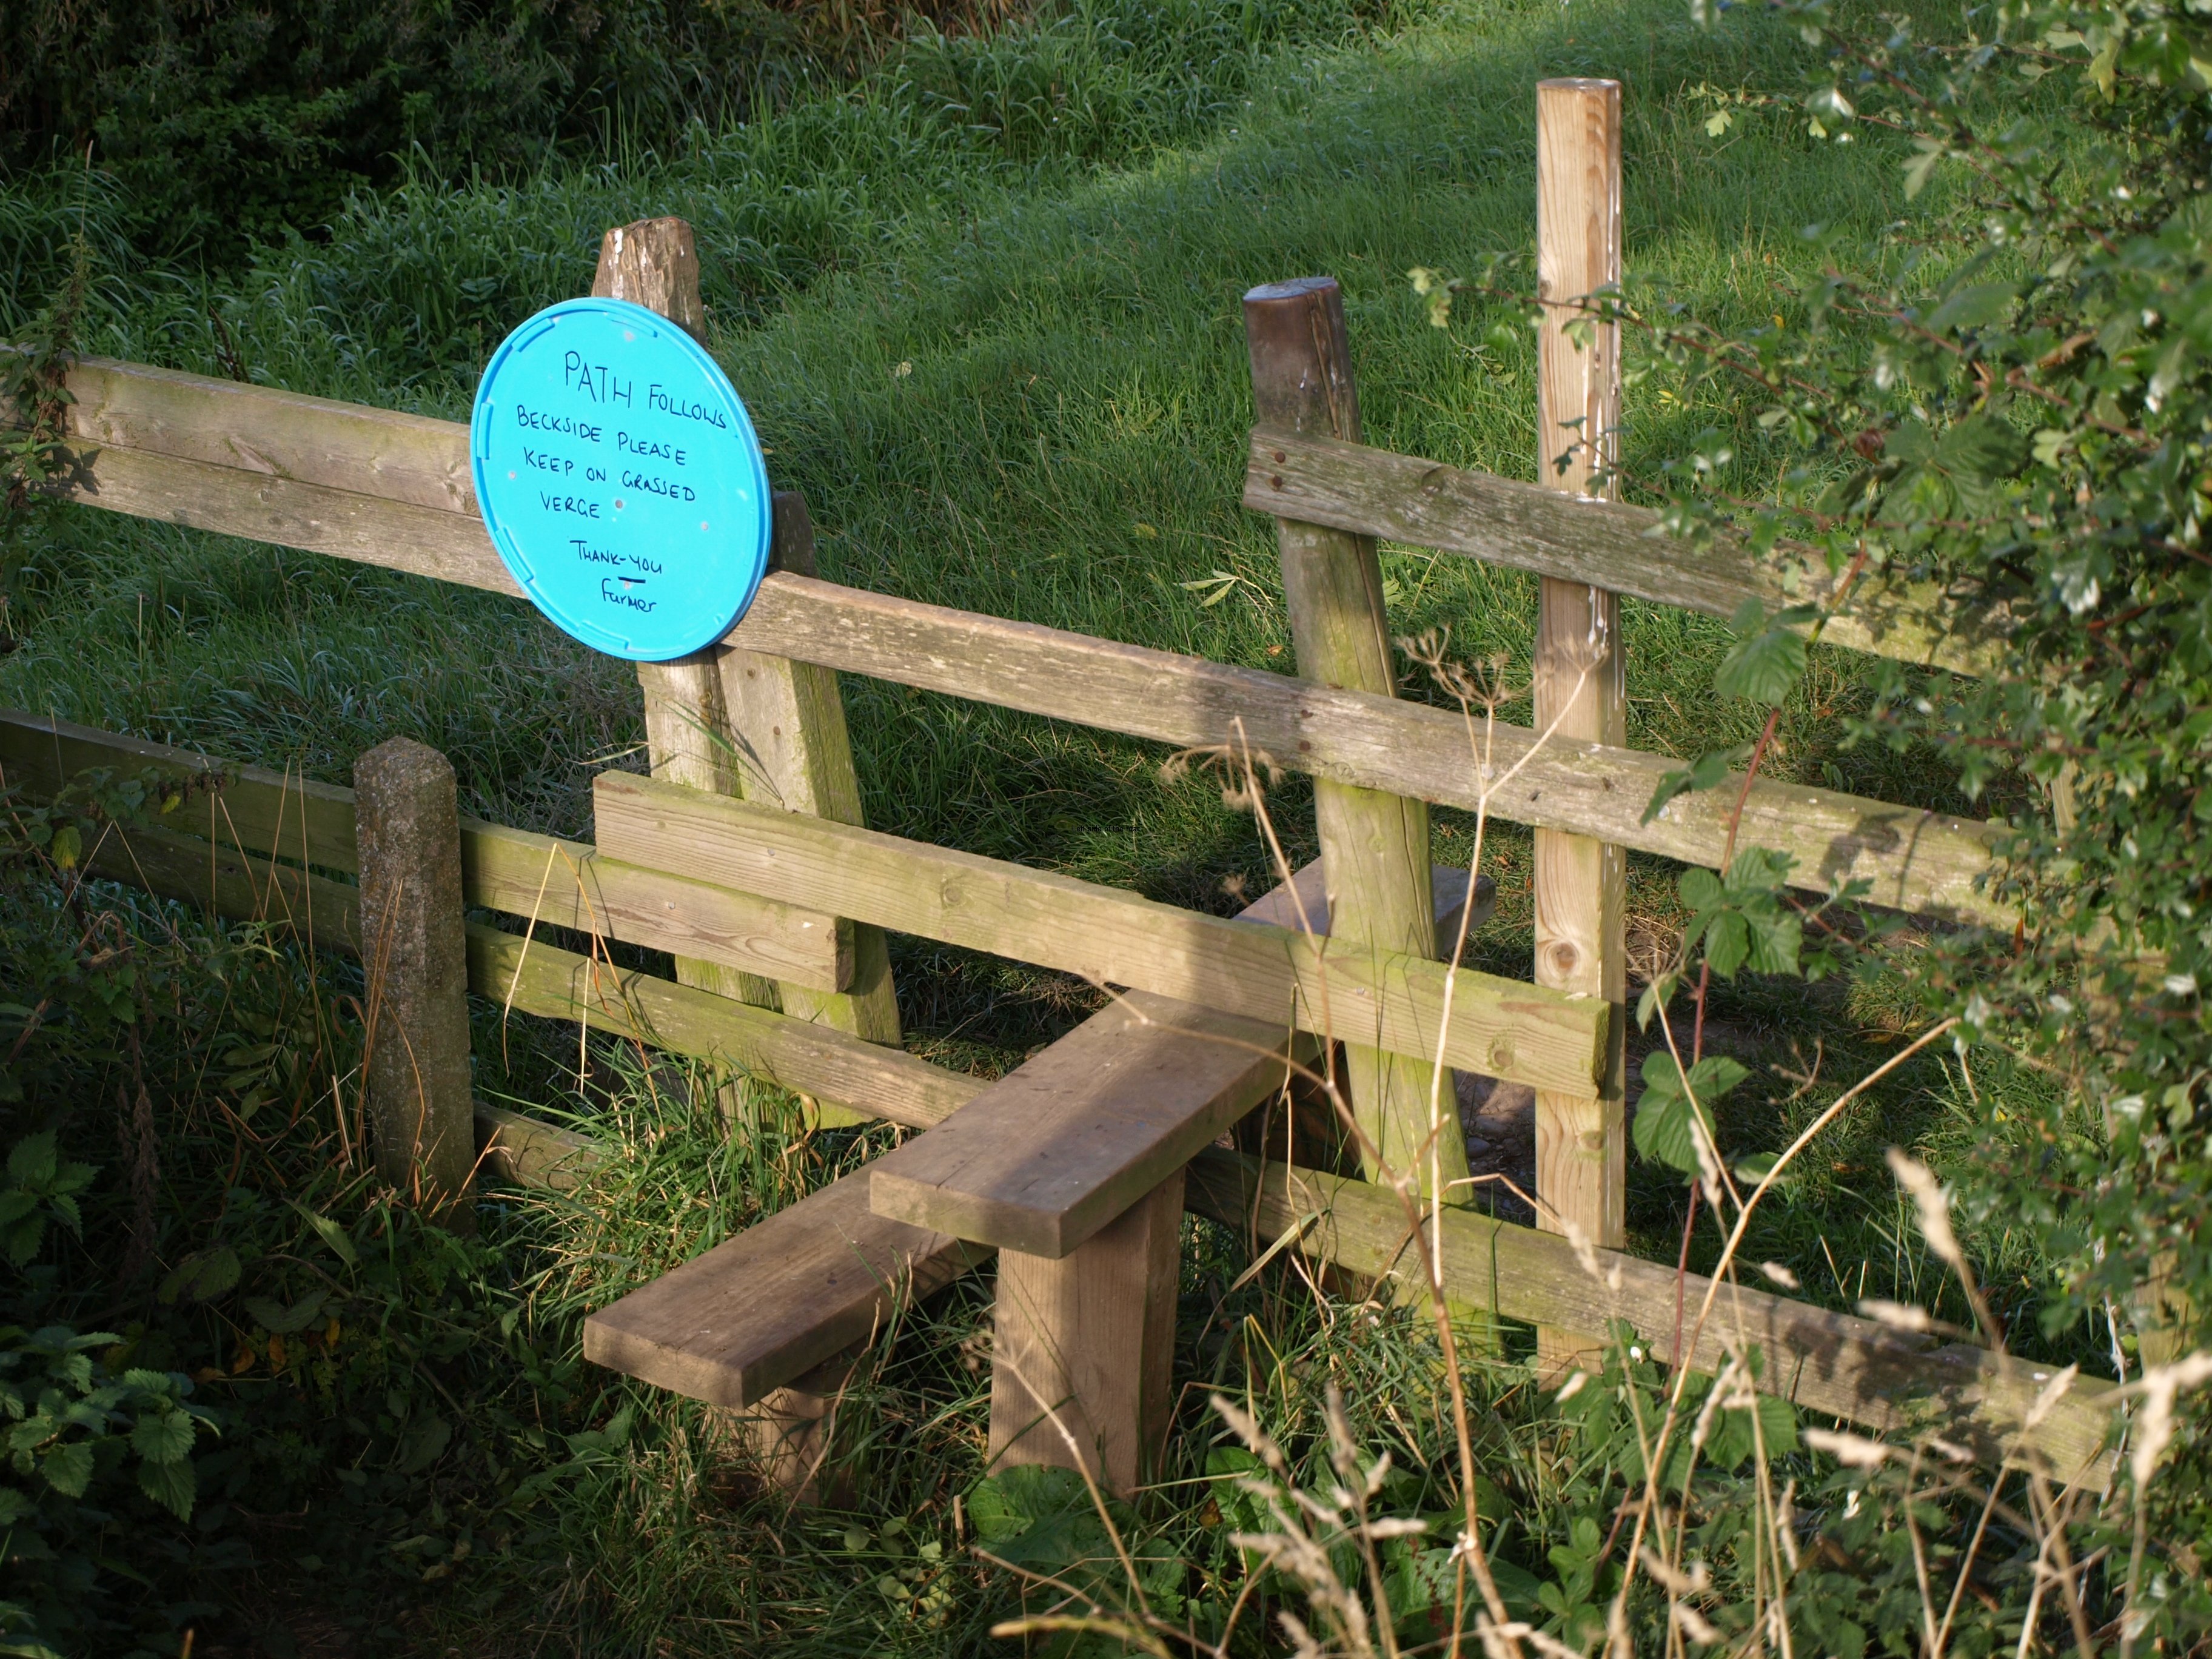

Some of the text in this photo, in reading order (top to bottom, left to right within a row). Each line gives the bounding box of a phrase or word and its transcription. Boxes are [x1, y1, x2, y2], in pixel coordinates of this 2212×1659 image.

[565, 351, 726, 429] PATH FOLLOWS
[517, 405, 686, 466] BECKSIDE PLEASE
[524, 448, 695, 501] KEEP ON GRASSED
[541, 492, 600, 518] VERGE
